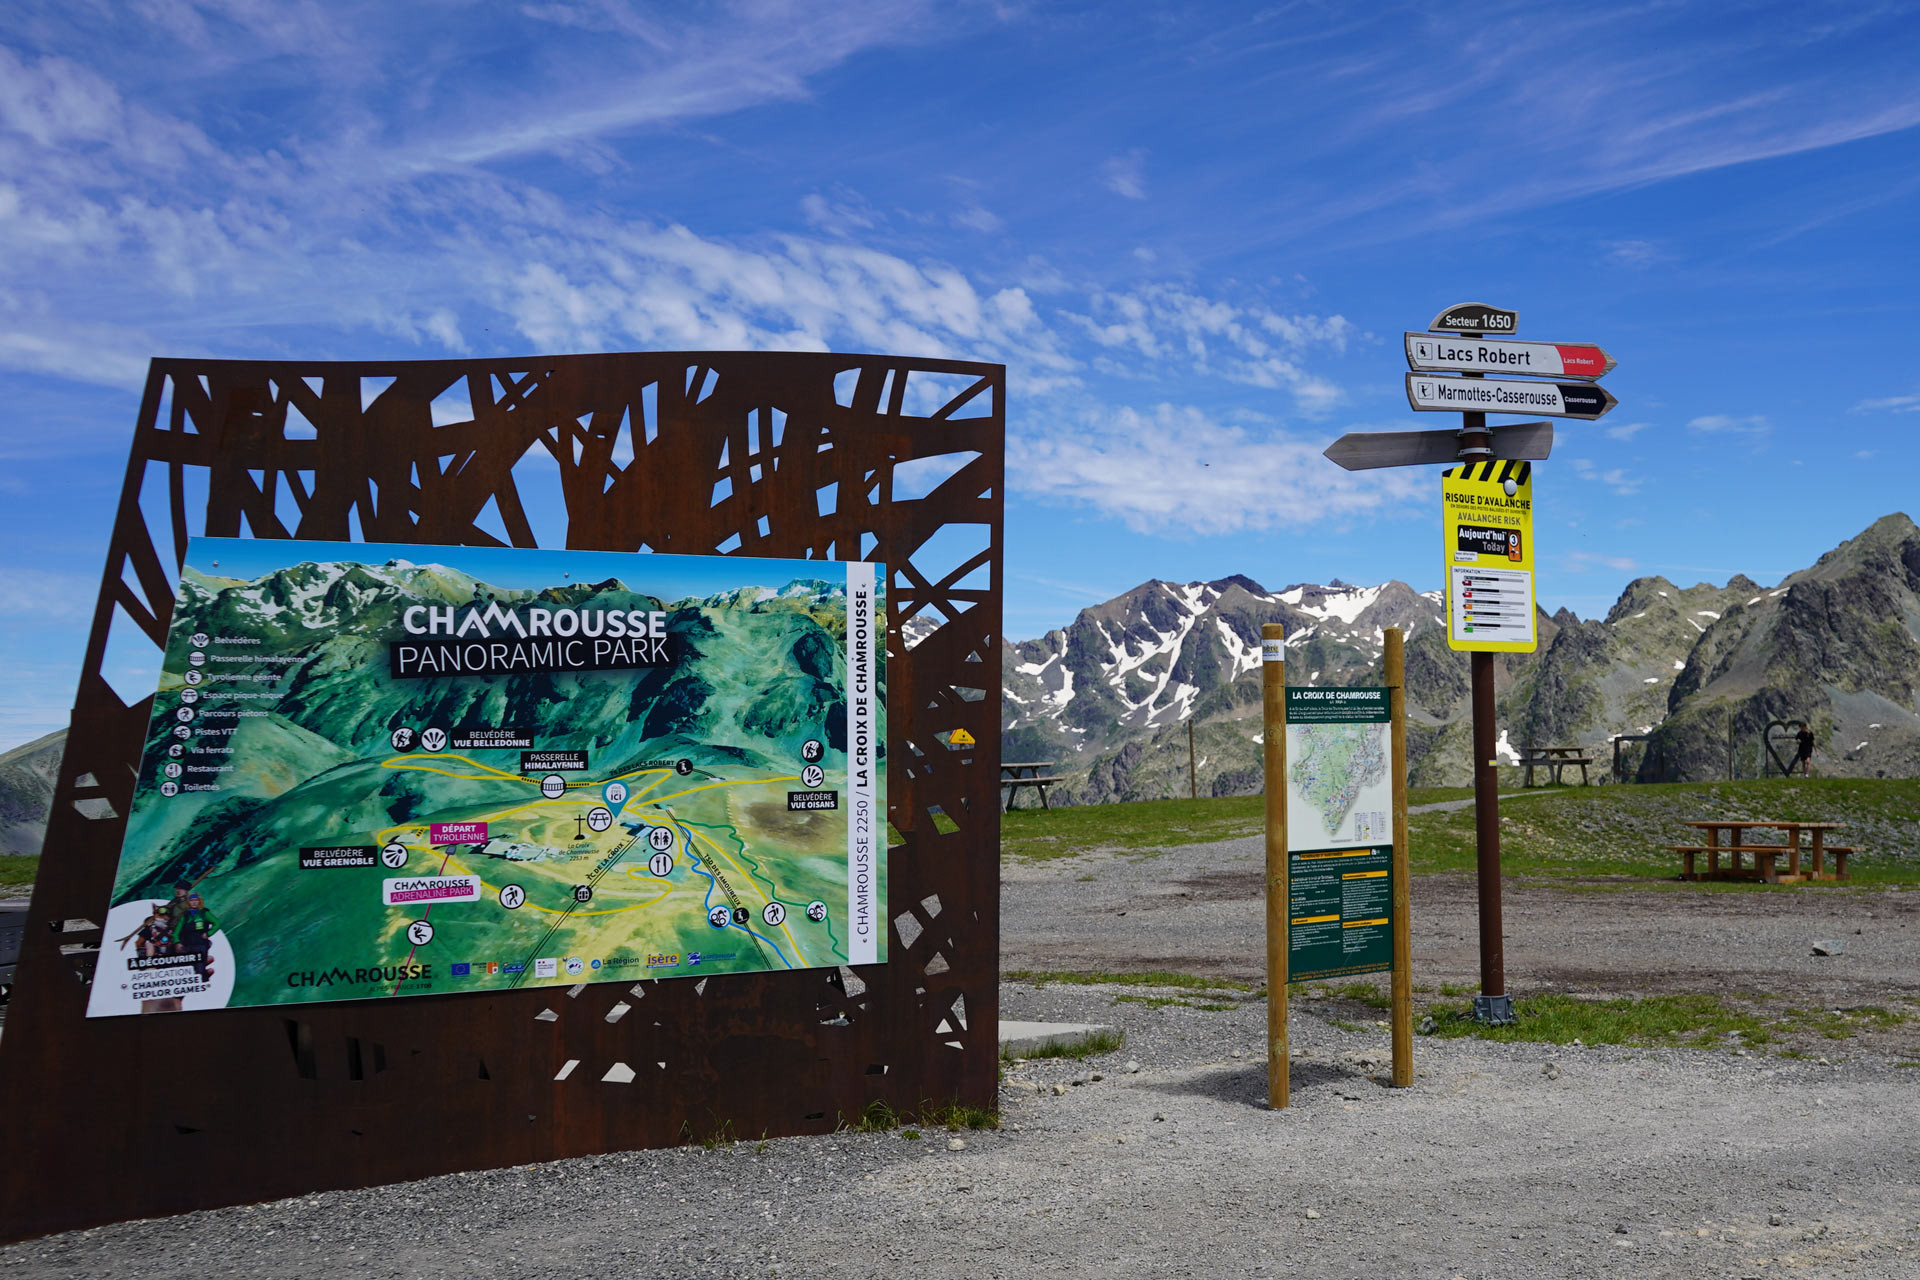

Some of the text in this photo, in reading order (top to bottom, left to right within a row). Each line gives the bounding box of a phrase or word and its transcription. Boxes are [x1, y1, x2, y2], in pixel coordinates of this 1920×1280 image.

[1446, 314, 1511, 328] Secteur 1650
[1437, 344, 1530, 365] Lacs Robert
[1438, 384, 1557, 406] Marmottes-Casserousse
[1564, 396, 1597, 404] Casserousse
[1446, 492, 1530, 510] RISQUE D'AVALANCHE
[1458, 512, 1520, 525] AVALANCHE RISK
[1459, 528, 1516, 545] Aujourd'hui 3
[1482, 541, 1506, 554] Today
[403, 601, 667, 639] CHAMROUSSE
[214, 636, 261, 644] Belvédères
[856, 591, 867, 693] CHAMROUSSE
[254, 655, 307, 664] himalayenne
[400, 637, 669, 673] PANORAMIC PARK
[207, 673, 281, 682] Tyrolienne géante
[203, 692, 284, 700] Espace pique-nique
[1292, 691, 1381, 699] LA CROIX DE CHAMROUSSE
[856, 698, 867, 716] DE
[237, 710, 269, 718] piétons
[470, 730, 515, 738] BELVÉDÈRE
[856, 720, 867, 766] CROIX
[857, 770, 867, 787] LA
[793, 793, 832, 801] BELVÉDÈRE
[857, 800, 868, 833] 2250
[442, 824, 476, 833] DÉPART
[433, 833, 485, 841] TYROLIENNE
[314, 848, 363, 858] BELVÉDÈRE
[594, 864, 602, 874] DE
[601, 858, 609, 866] LA
[608, 842, 624, 859] CROIX
[324, 857, 374, 866] GRENOBLE
[394, 879, 470, 890] CHAMROUSSE
[712, 865, 721, 876] DES
[719, 876, 741, 905] AMOUREUX
[857, 836, 868, 935] CHAMROUSSE
[392, 886, 472, 902] ADRENALINE PARK
[130, 958, 138, 968] À
[139, 954, 196, 967] DÉCOUVRIR
[613, 957, 639, 966] Région
[647, 953, 677, 965] isère
[132, 968, 192, 980] APPLICATION
[287, 965, 432, 987] CHAMROUSSE
[132, 976, 199, 990] CHAMROUSSE
[133, 988, 171, 999] EXPLOR
